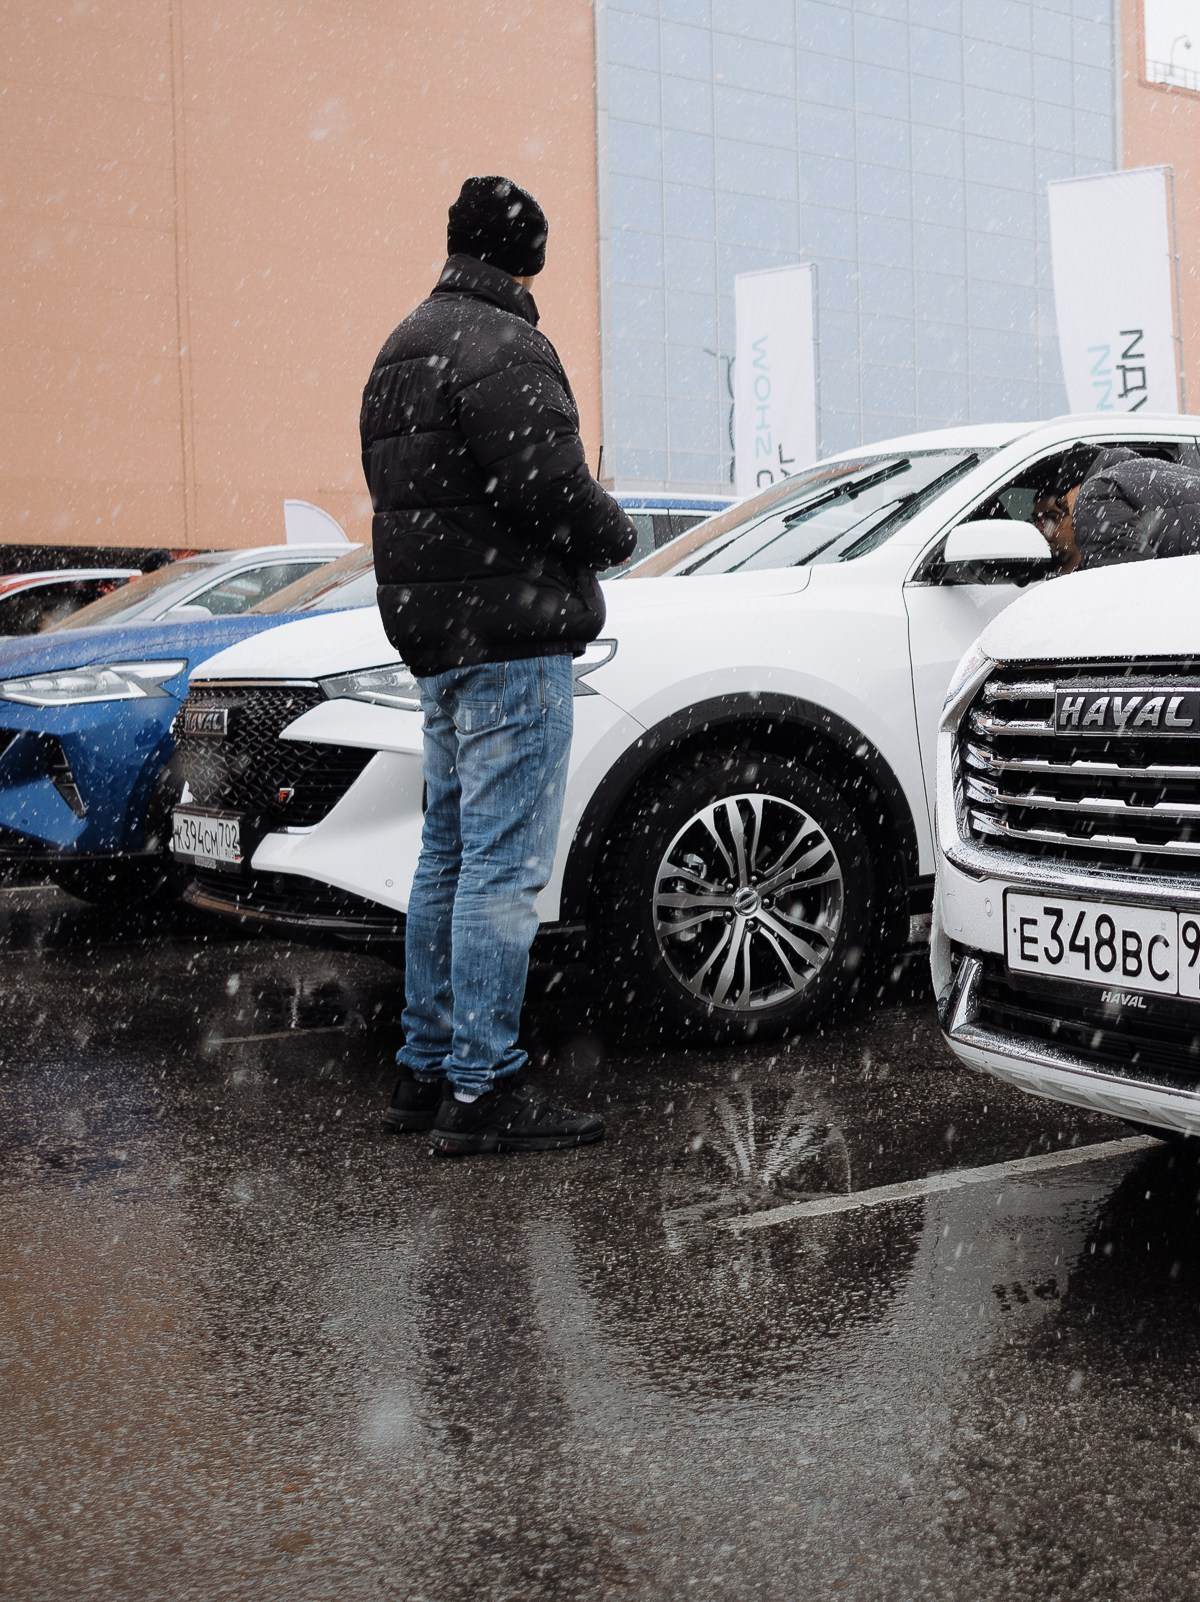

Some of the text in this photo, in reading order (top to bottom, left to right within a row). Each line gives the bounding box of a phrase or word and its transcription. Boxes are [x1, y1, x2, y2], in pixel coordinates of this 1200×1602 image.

[185, 712, 222, 730] HAVAL
[1059, 696, 1194, 727] HAVAL
[218, 822, 239, 850] 702
[1100, 990, 1148, 1009] HAVAL
